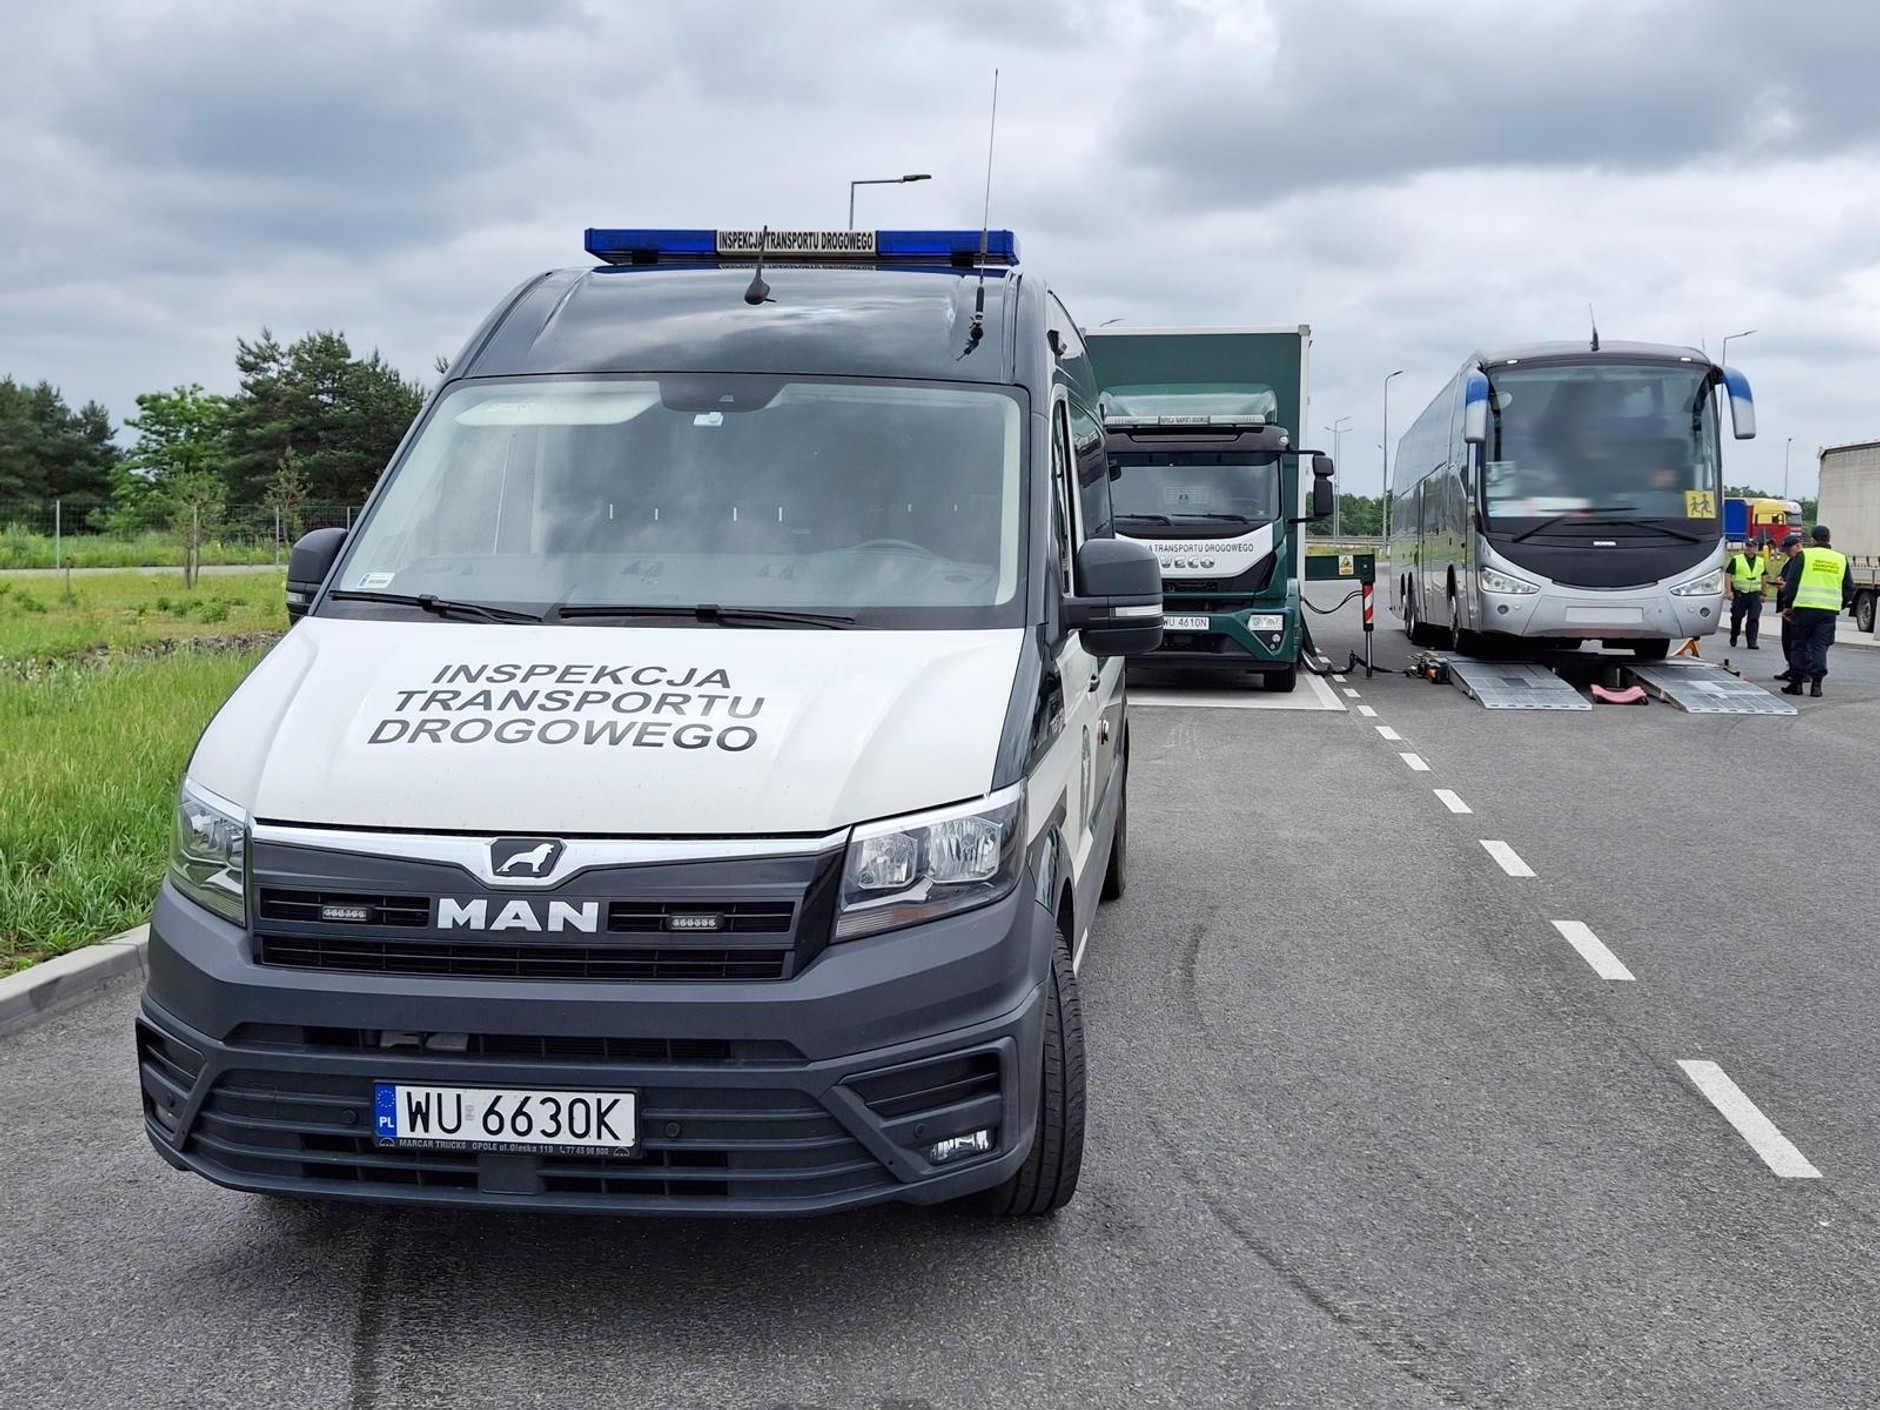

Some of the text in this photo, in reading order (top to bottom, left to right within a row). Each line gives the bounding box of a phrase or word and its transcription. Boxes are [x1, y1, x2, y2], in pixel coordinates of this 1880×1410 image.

[719, 231, 873, 250] INSPEKCJA TRANSPORTU DROGOWEGO
[1154, 543, 1203, 553] TRANSPORTU
[1204, 543, 1254, 552] DROGOWEGO
[1160, 555, 1215, 569] VECO
[431, 664, 731, 688] INSPEKCJA
[395, 689, 765, 719] TRANSPORTU
[367, 718, 758, 752] DROGOWEGO
[436, 897, 599, 933] MAN
[379, 1116, 395, 1128] PL
[406, 1091, 621, 1140] WU 6630K
[400, 1139, 434, 1149] MARCAR
[436, 1140, 467, 1150] TRUCKS
[472, 1142, 498, 1151] OPOLE
